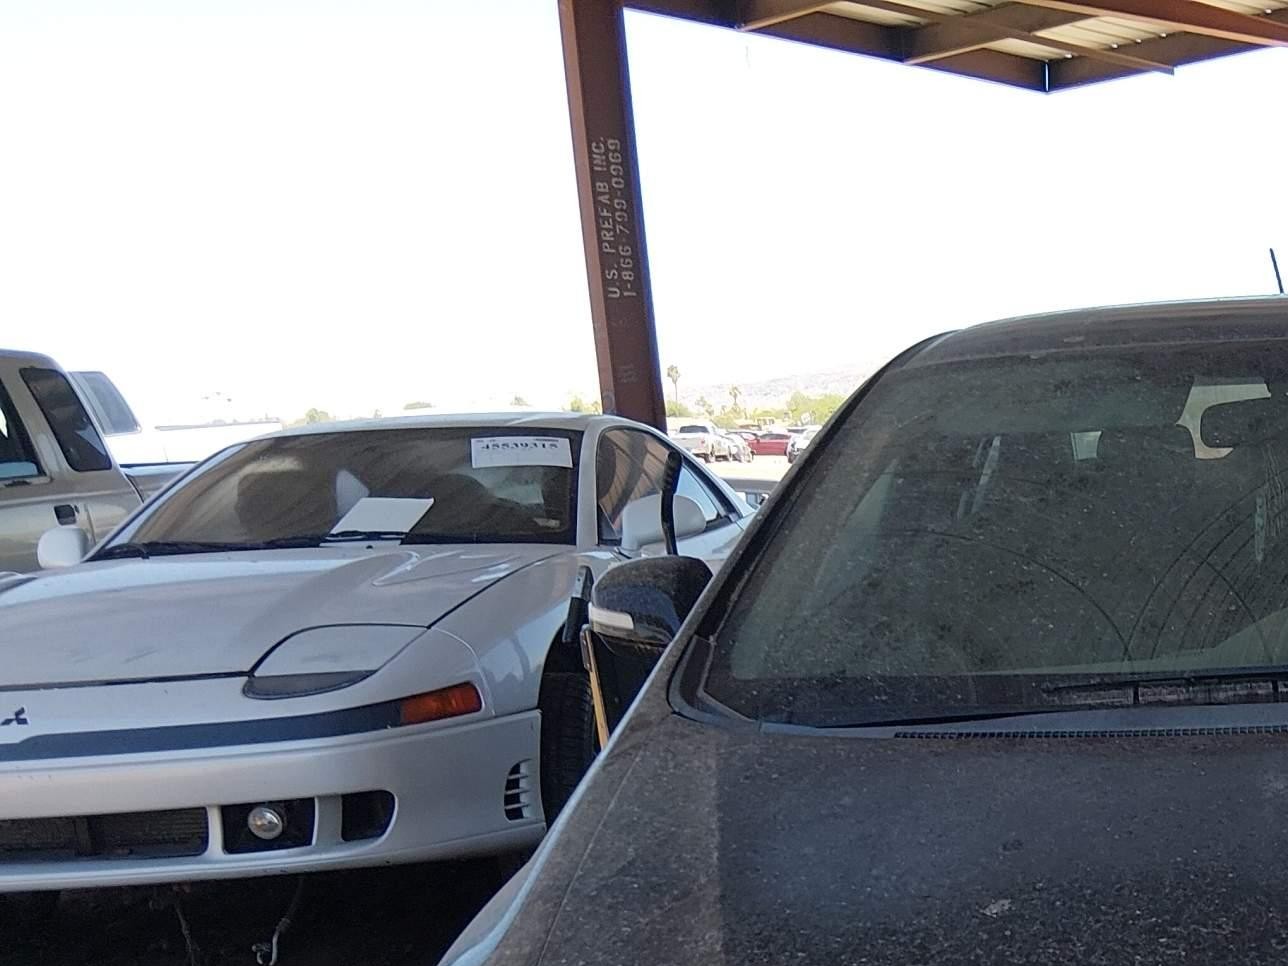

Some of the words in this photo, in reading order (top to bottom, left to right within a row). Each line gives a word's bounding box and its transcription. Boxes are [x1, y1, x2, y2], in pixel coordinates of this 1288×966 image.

[592, 136, 607, 171] INC.
[596, 181, 616, 253] PREFAB
[606, 263, 621, 298] U.S.
